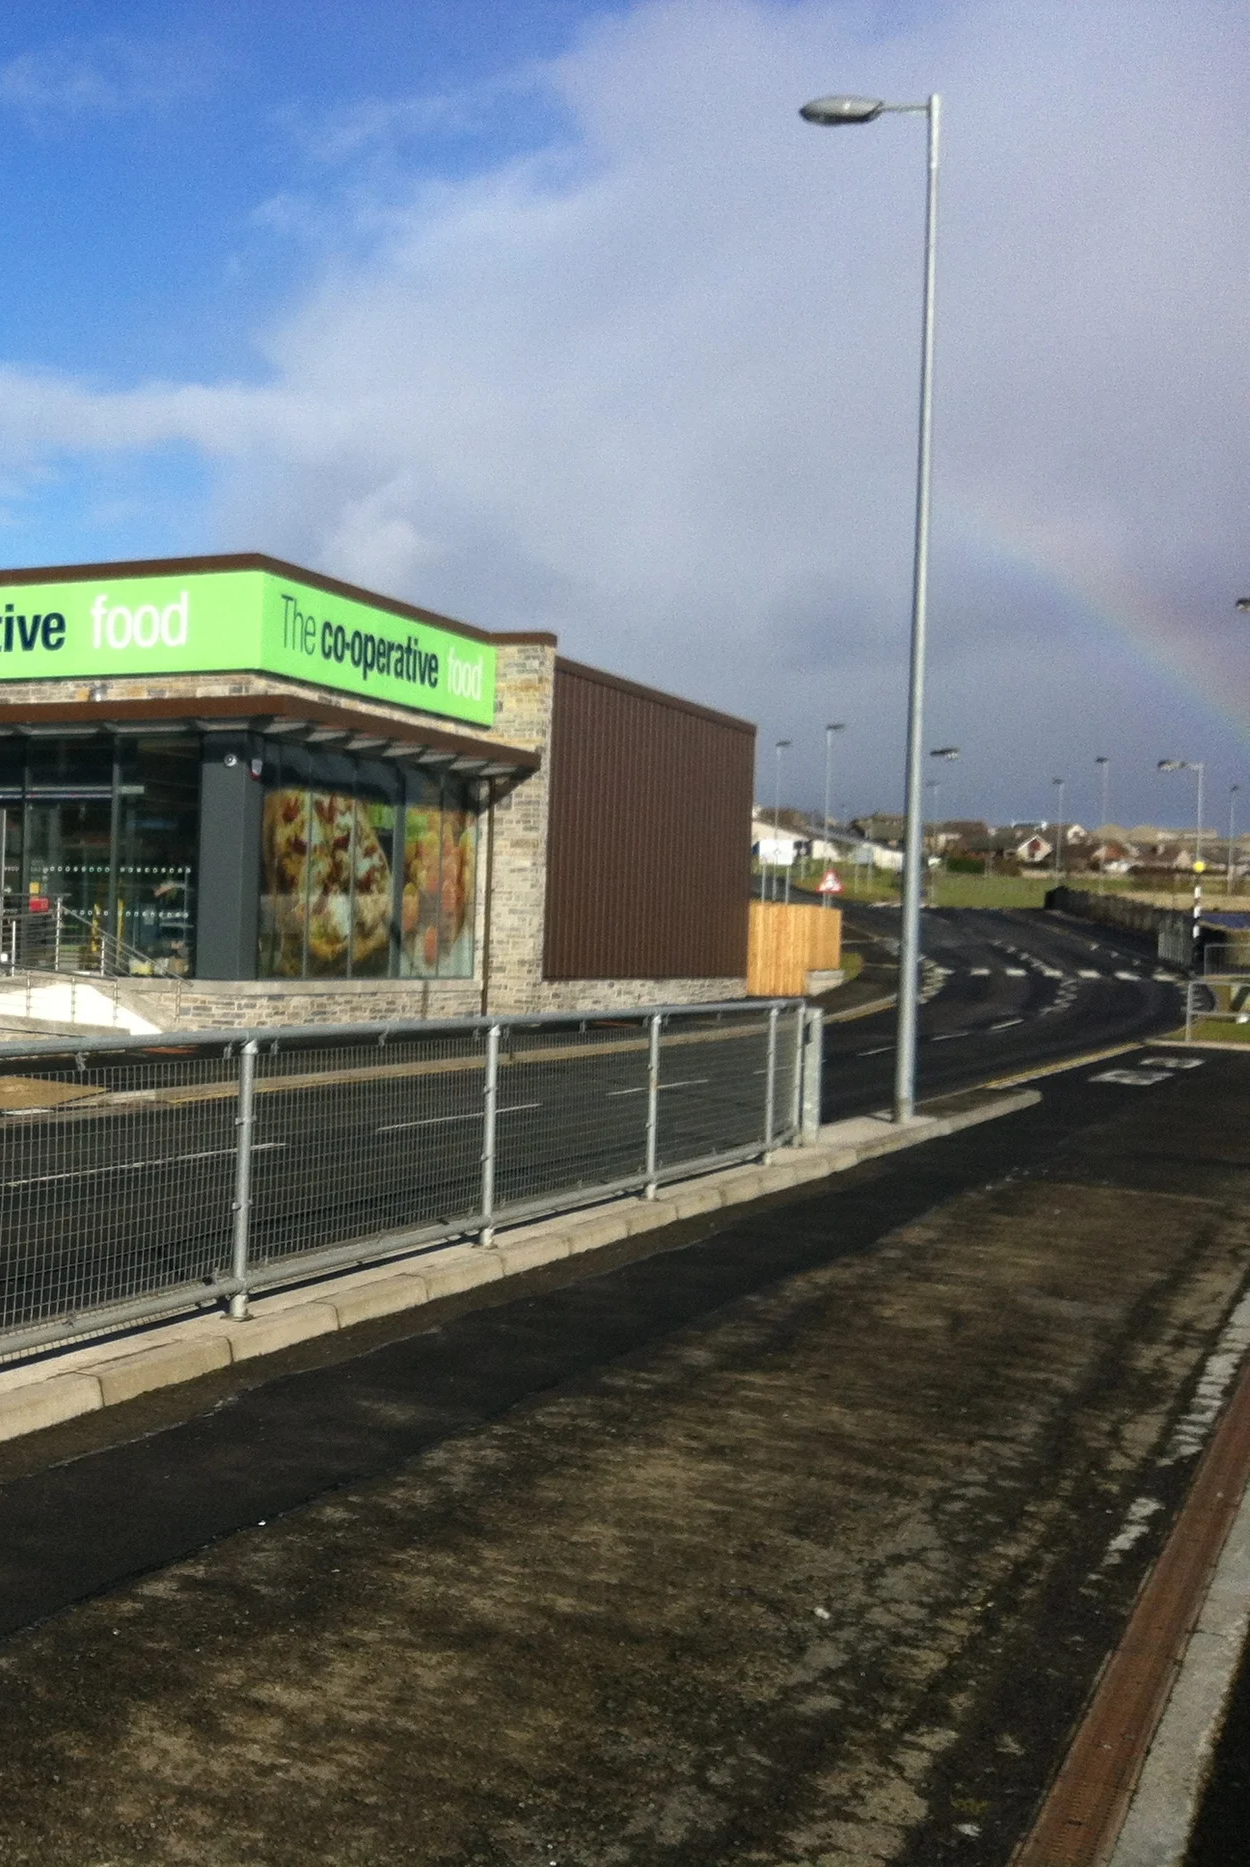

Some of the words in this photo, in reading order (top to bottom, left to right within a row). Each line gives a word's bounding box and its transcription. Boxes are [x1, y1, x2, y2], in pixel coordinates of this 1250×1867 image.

[90, 590, 190, 650] food
[281, 594, 316, 656] The
[321, 620, 439, 689] co-operative
[447, 646, 484, 702] food
